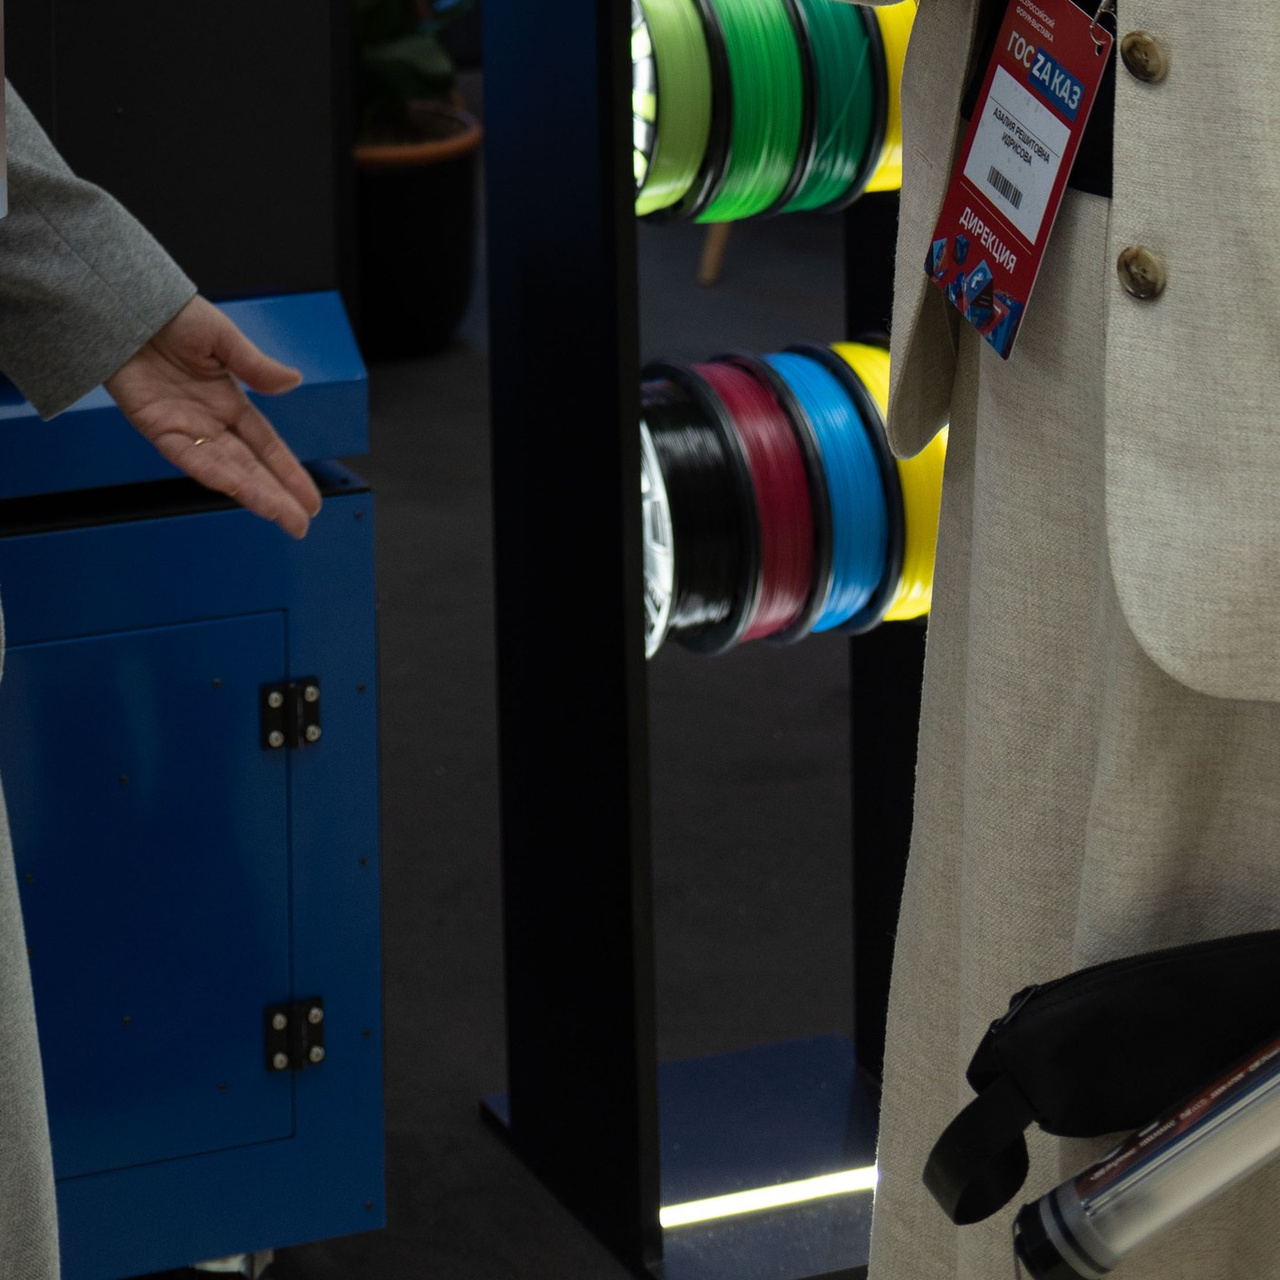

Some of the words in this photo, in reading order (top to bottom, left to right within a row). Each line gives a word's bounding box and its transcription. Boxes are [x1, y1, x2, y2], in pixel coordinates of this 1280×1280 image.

[993, 107, 1016, 132] АЗАЛИЯ
[1013, 125, 1051, 165] РЕШИТОВНА
[1001, 131, 1033, 167] ИДРИСОВА
[958, 206, 1018, 275] ДИРЕКЦИЯ
